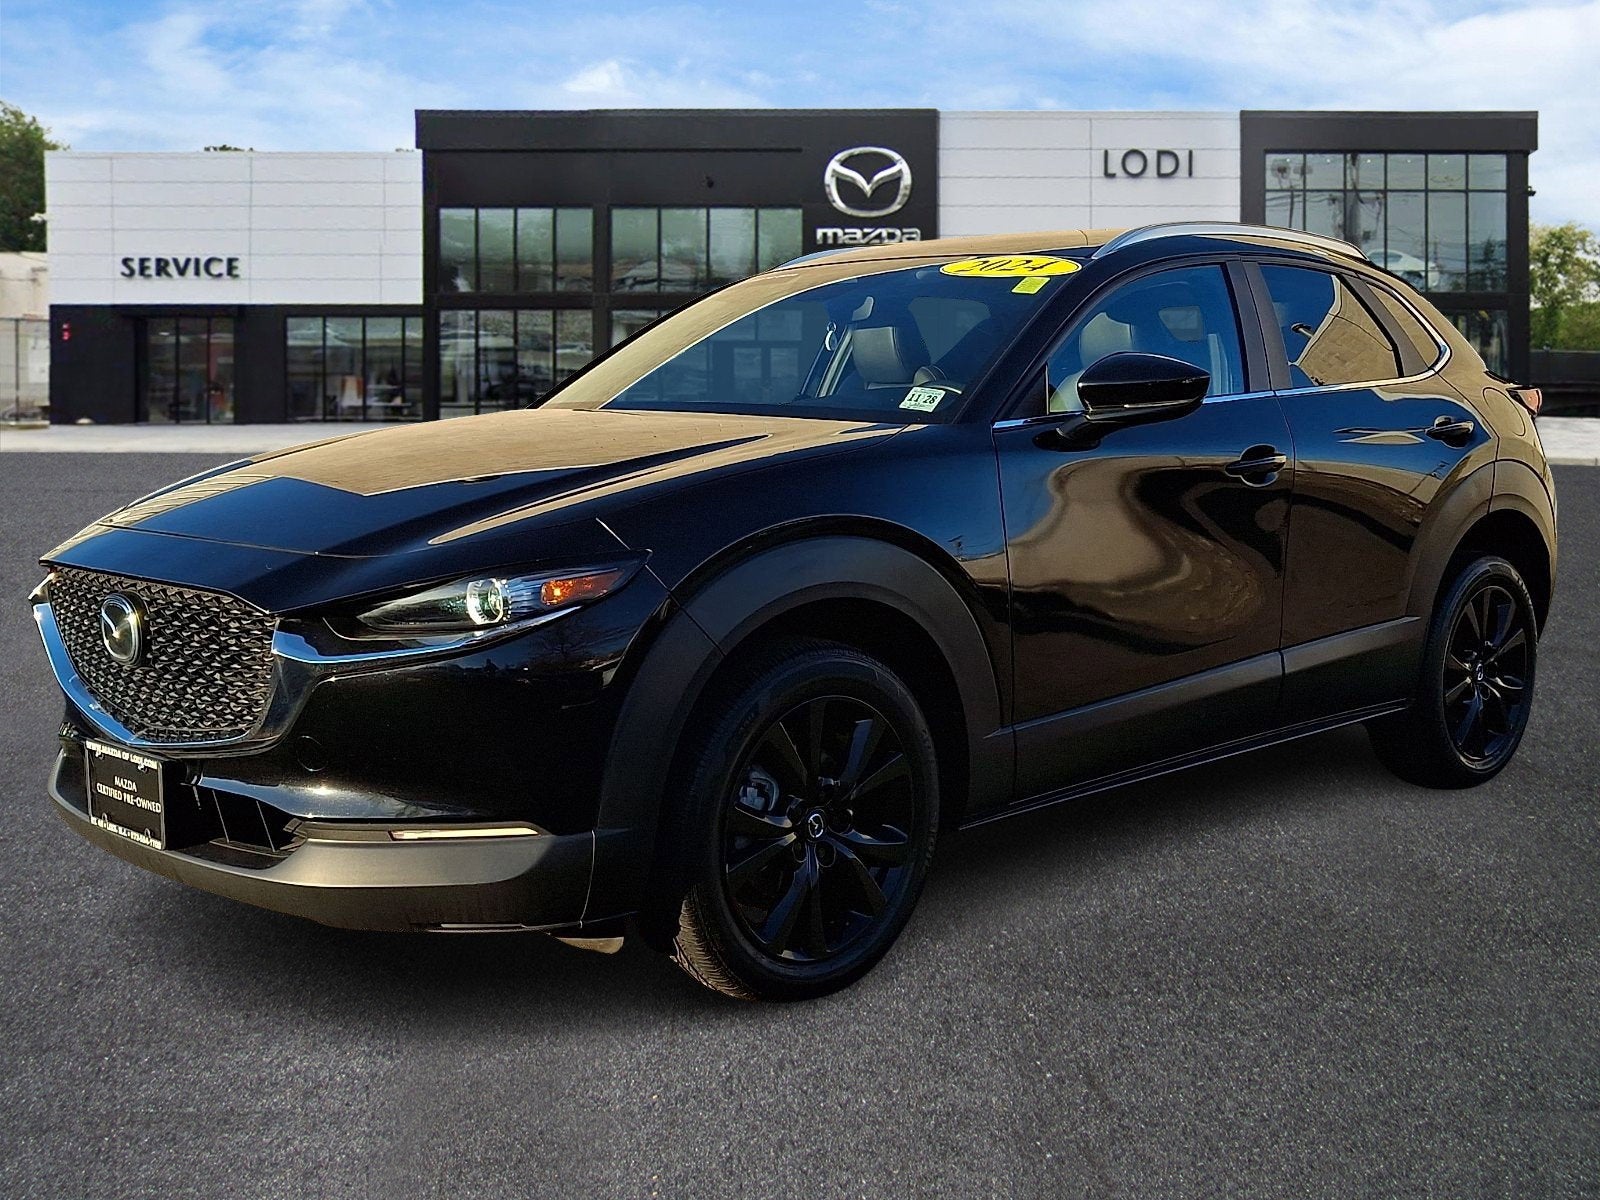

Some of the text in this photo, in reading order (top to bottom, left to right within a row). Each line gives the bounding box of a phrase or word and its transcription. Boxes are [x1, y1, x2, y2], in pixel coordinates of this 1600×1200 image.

[1103, 149, 1193, 178] LODI
[120, 257, 240, 278] SERVICE
[954, 260, 1059, 272] 2024
[907, 394, 938, 404] 11 28
[114, 776, 137, 792] MAZDA
[96, 782, 161, 813] CERTIFIED PRE-OWNED
